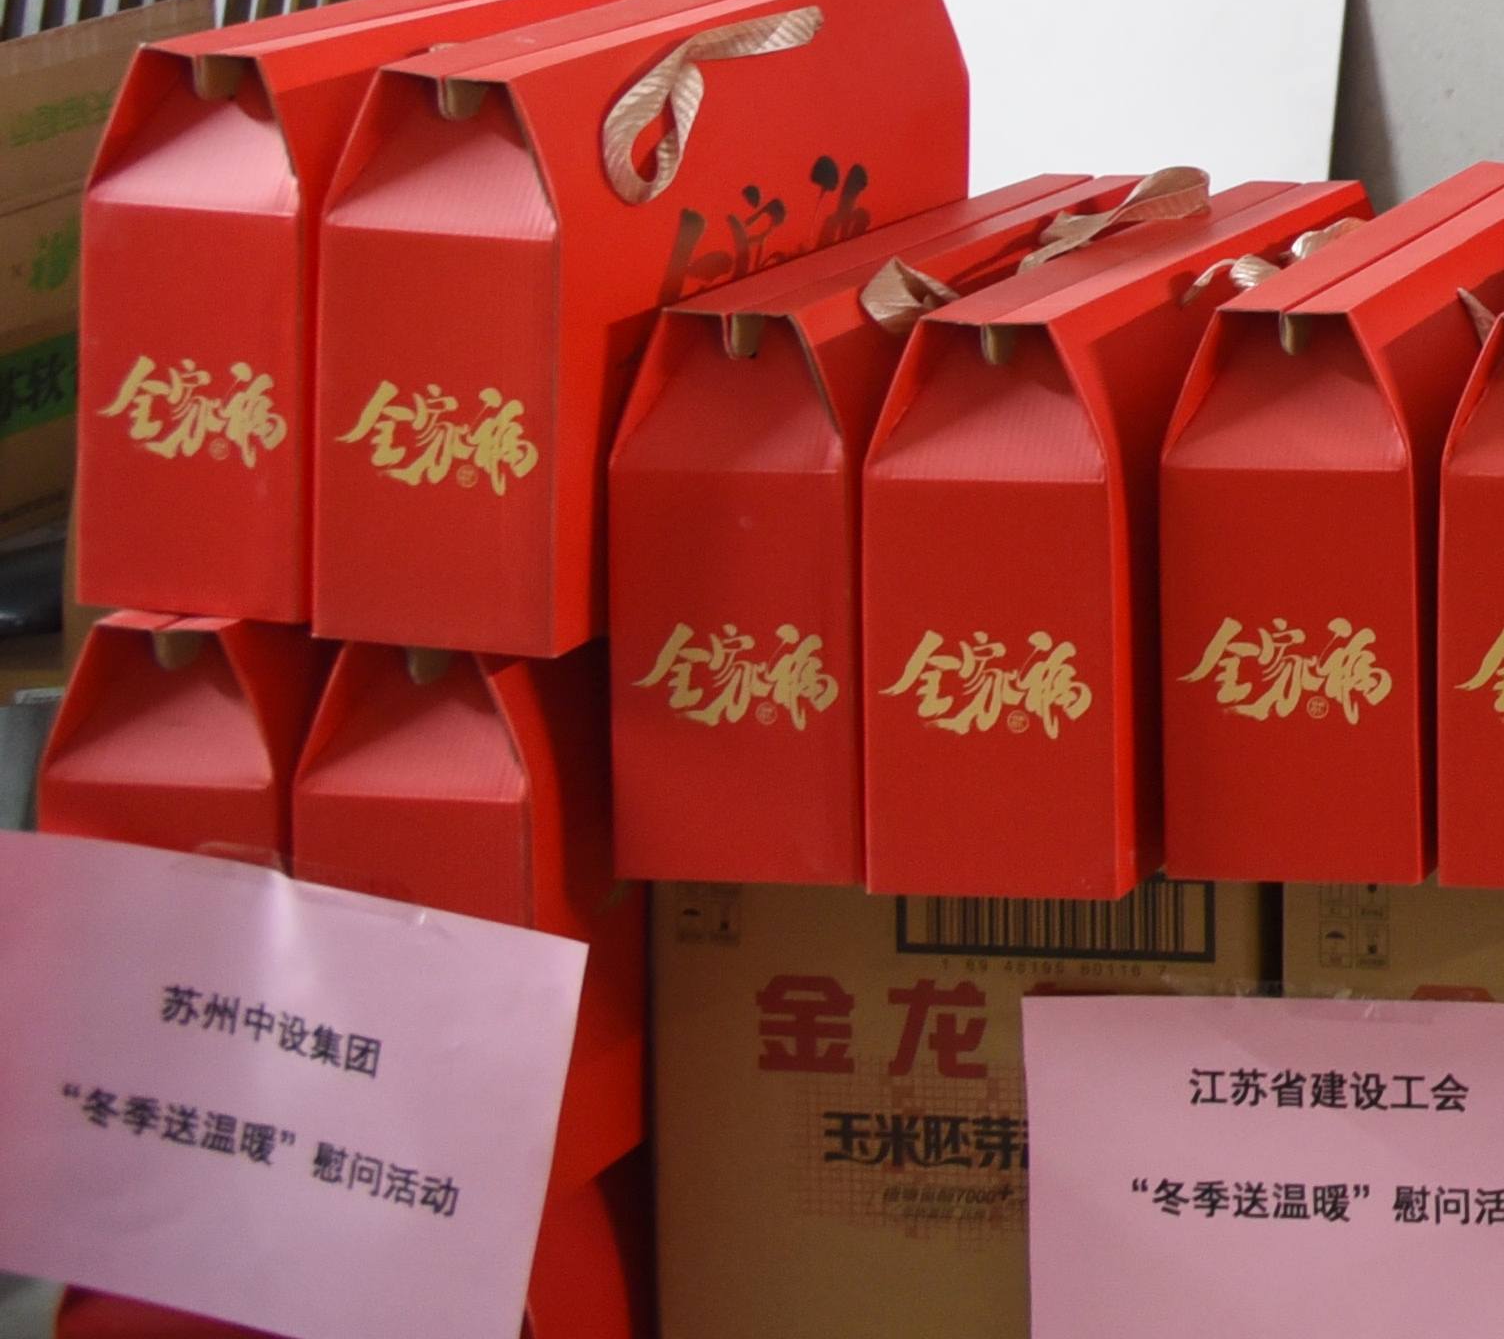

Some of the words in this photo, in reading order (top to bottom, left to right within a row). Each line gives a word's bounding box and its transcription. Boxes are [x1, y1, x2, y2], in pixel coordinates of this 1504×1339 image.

[98, 356, 289, 469] 全家福
[336, 379, 540, 497] 全家福
[631, 621, 840, 729] 全家福
[880, 629, 1093, 739] 全家福
[1178, 616, 1393, 724] 全家福
[160, 984, 383, 1079] 苏州中设集团
[823, 1109, 1030, 1170] 玉米胚芽
[1188, 1067, 1470, 1116] 江苏省建设工会
[61, 1081, 297, 1167] “冬季送温暖”
[311, 1139, 462, 1218] 慰问活动
[1130, 1176, 1373, 1227] “冬季送温暖”
